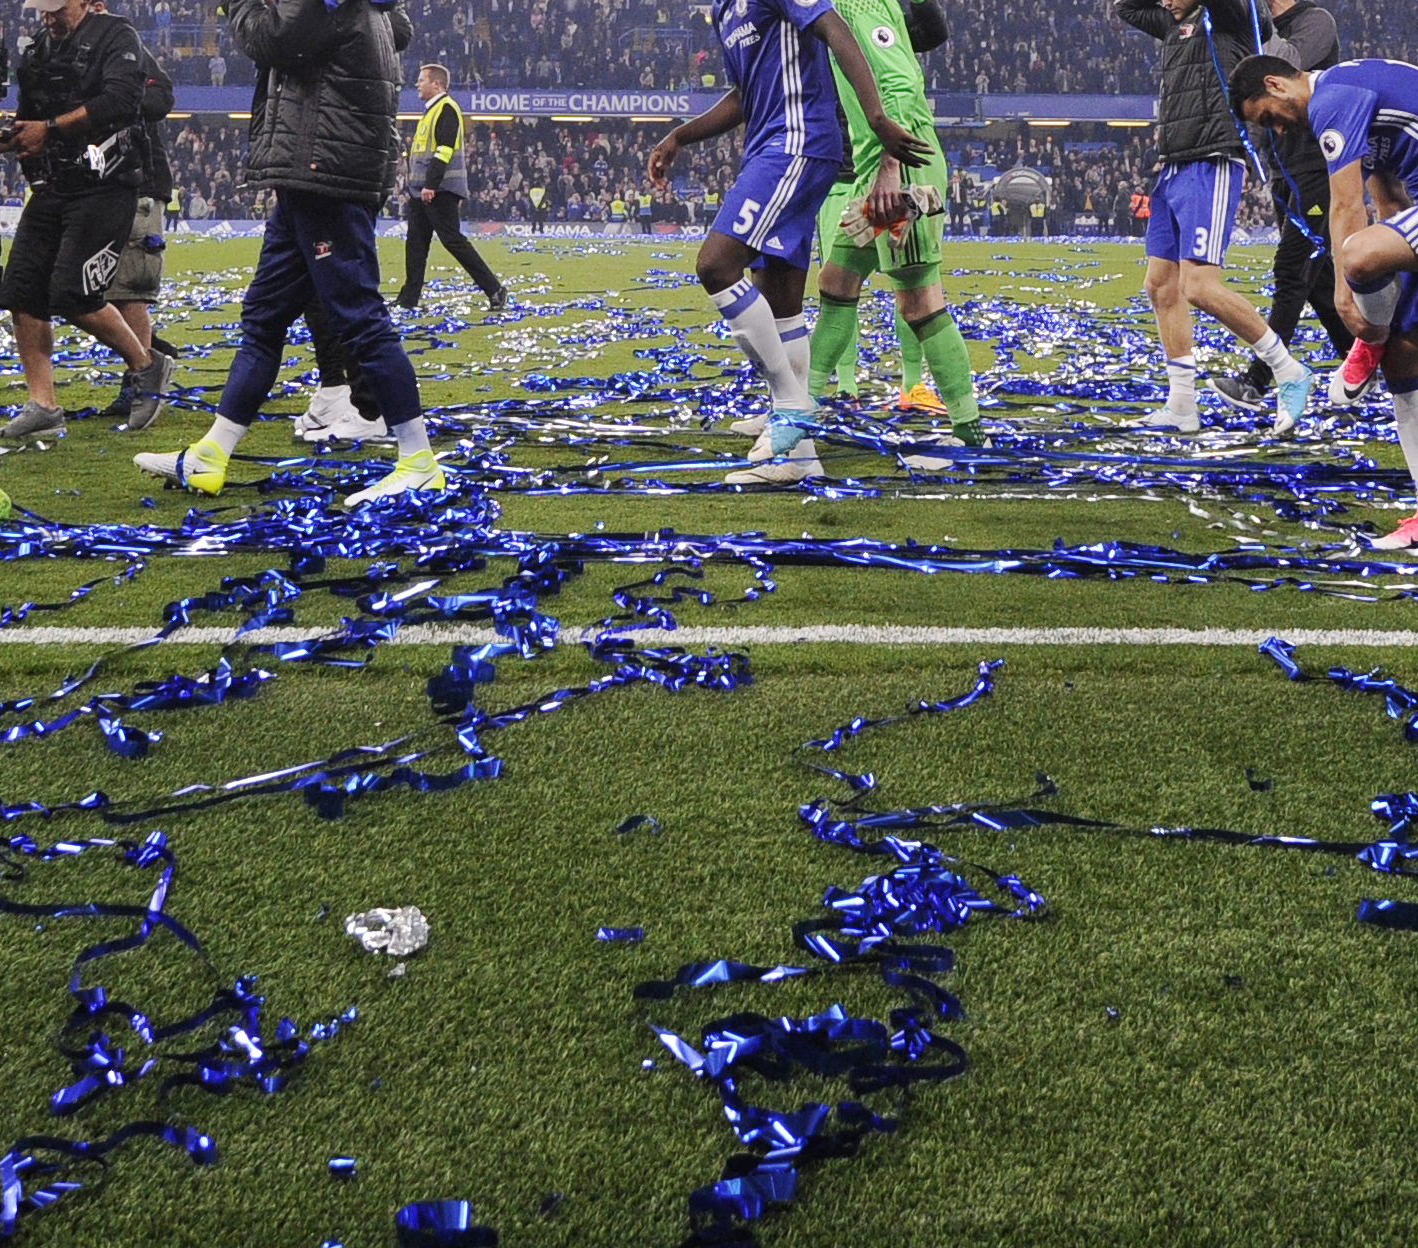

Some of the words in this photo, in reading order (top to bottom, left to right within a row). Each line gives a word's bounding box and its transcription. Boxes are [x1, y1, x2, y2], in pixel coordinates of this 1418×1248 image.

[471, 94, 530, 110] HOME
[533, 98, 547, 107] OF
[549, 98, 567, 107] THE
[569, 94, 690, 112] CHAMPIONS
[732, 198, 761, 235] 5
[1193, 227, 1209, 256] 3
